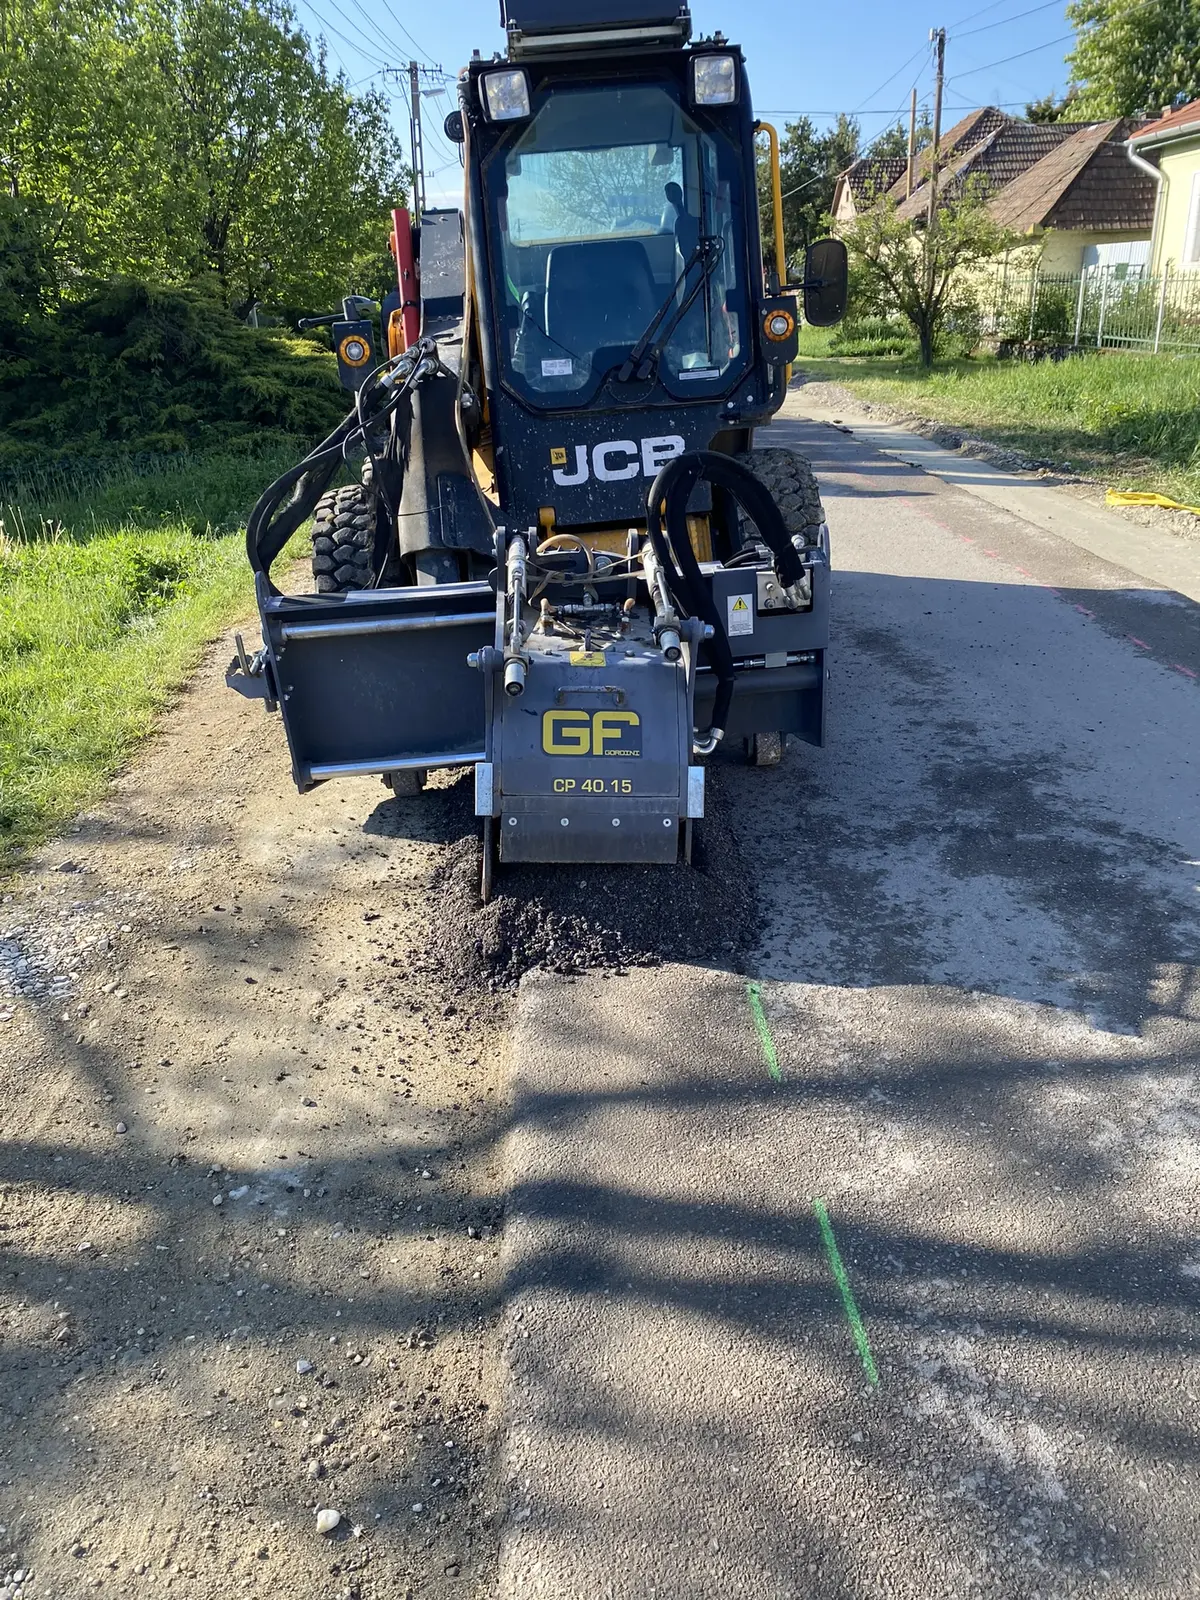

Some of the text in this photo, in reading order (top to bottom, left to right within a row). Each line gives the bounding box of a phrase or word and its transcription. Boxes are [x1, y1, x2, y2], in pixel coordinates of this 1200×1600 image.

[553, 435, 686, 486] JCB
[543, 710, 640, 755] GF
[553, 778, 632, 793] CP 40.15
